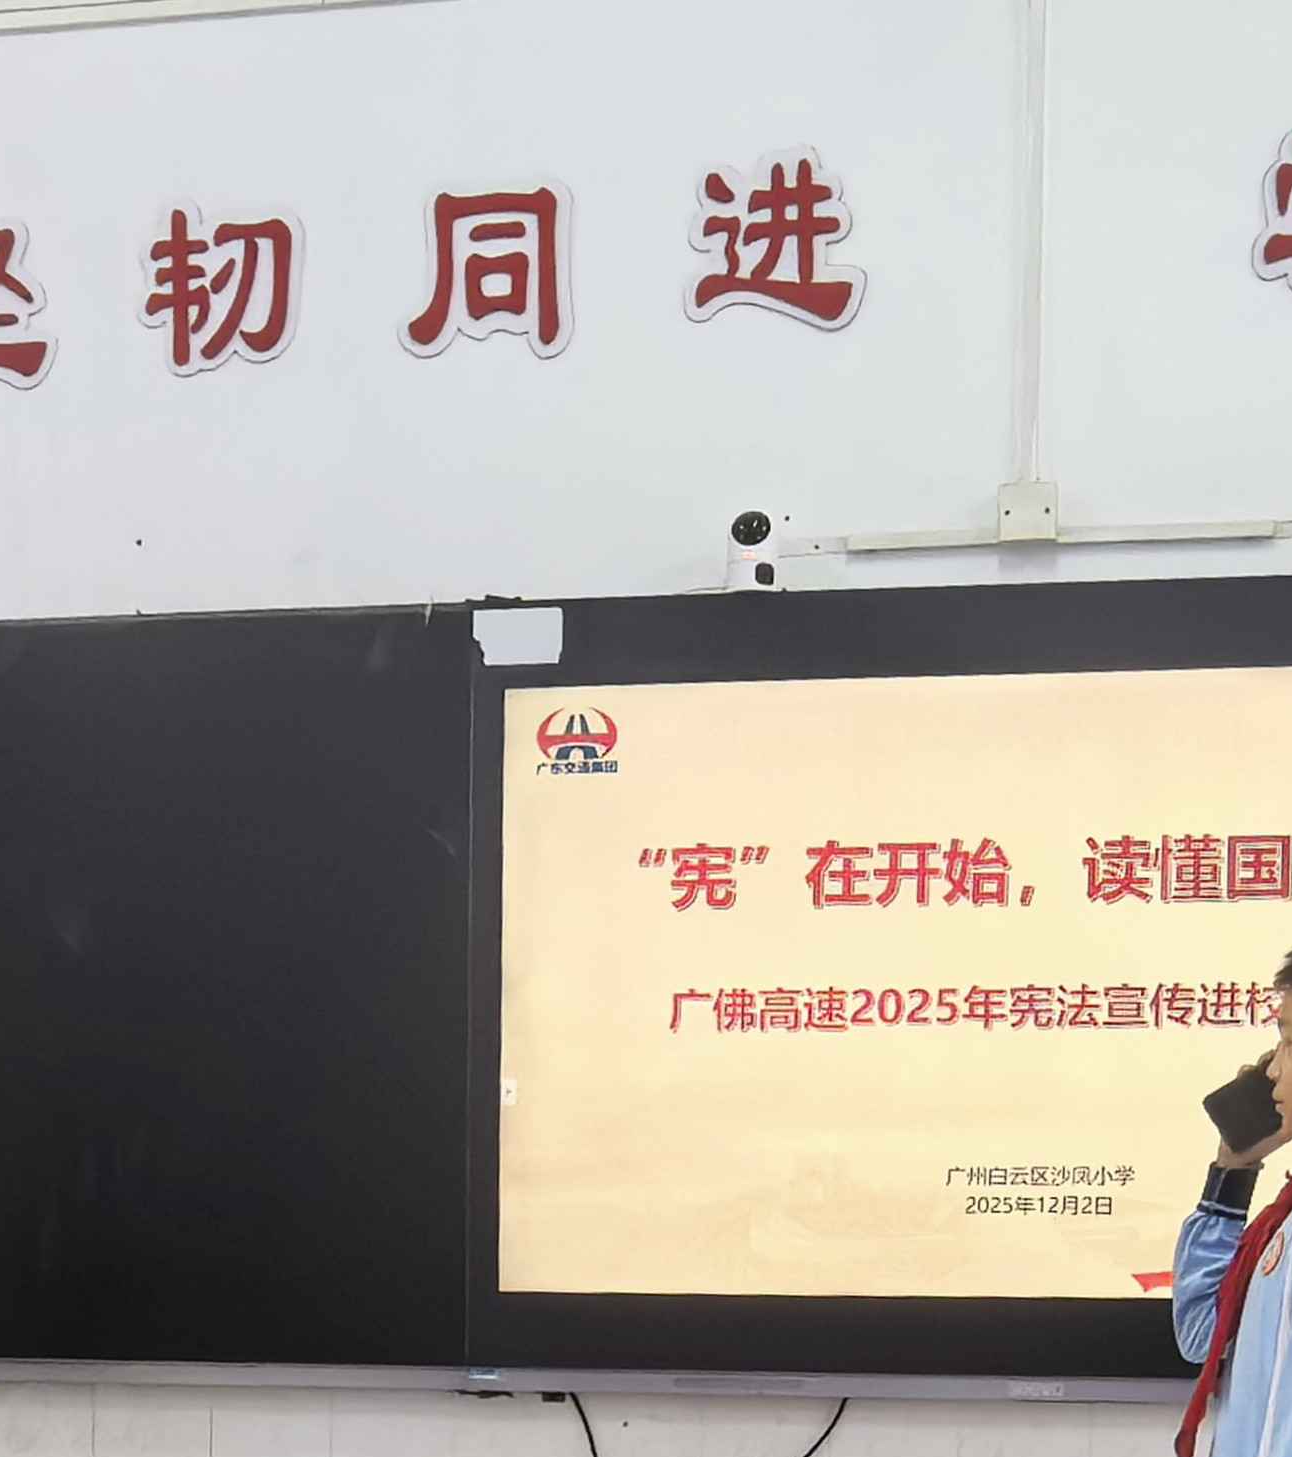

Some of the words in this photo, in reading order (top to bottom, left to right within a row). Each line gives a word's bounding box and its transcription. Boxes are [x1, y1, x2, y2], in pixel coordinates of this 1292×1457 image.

[946, 1165, 1136, 1187] 广州白云区沙凤小学
[965, 1195, 1113, 1215] 2025年12月2日
